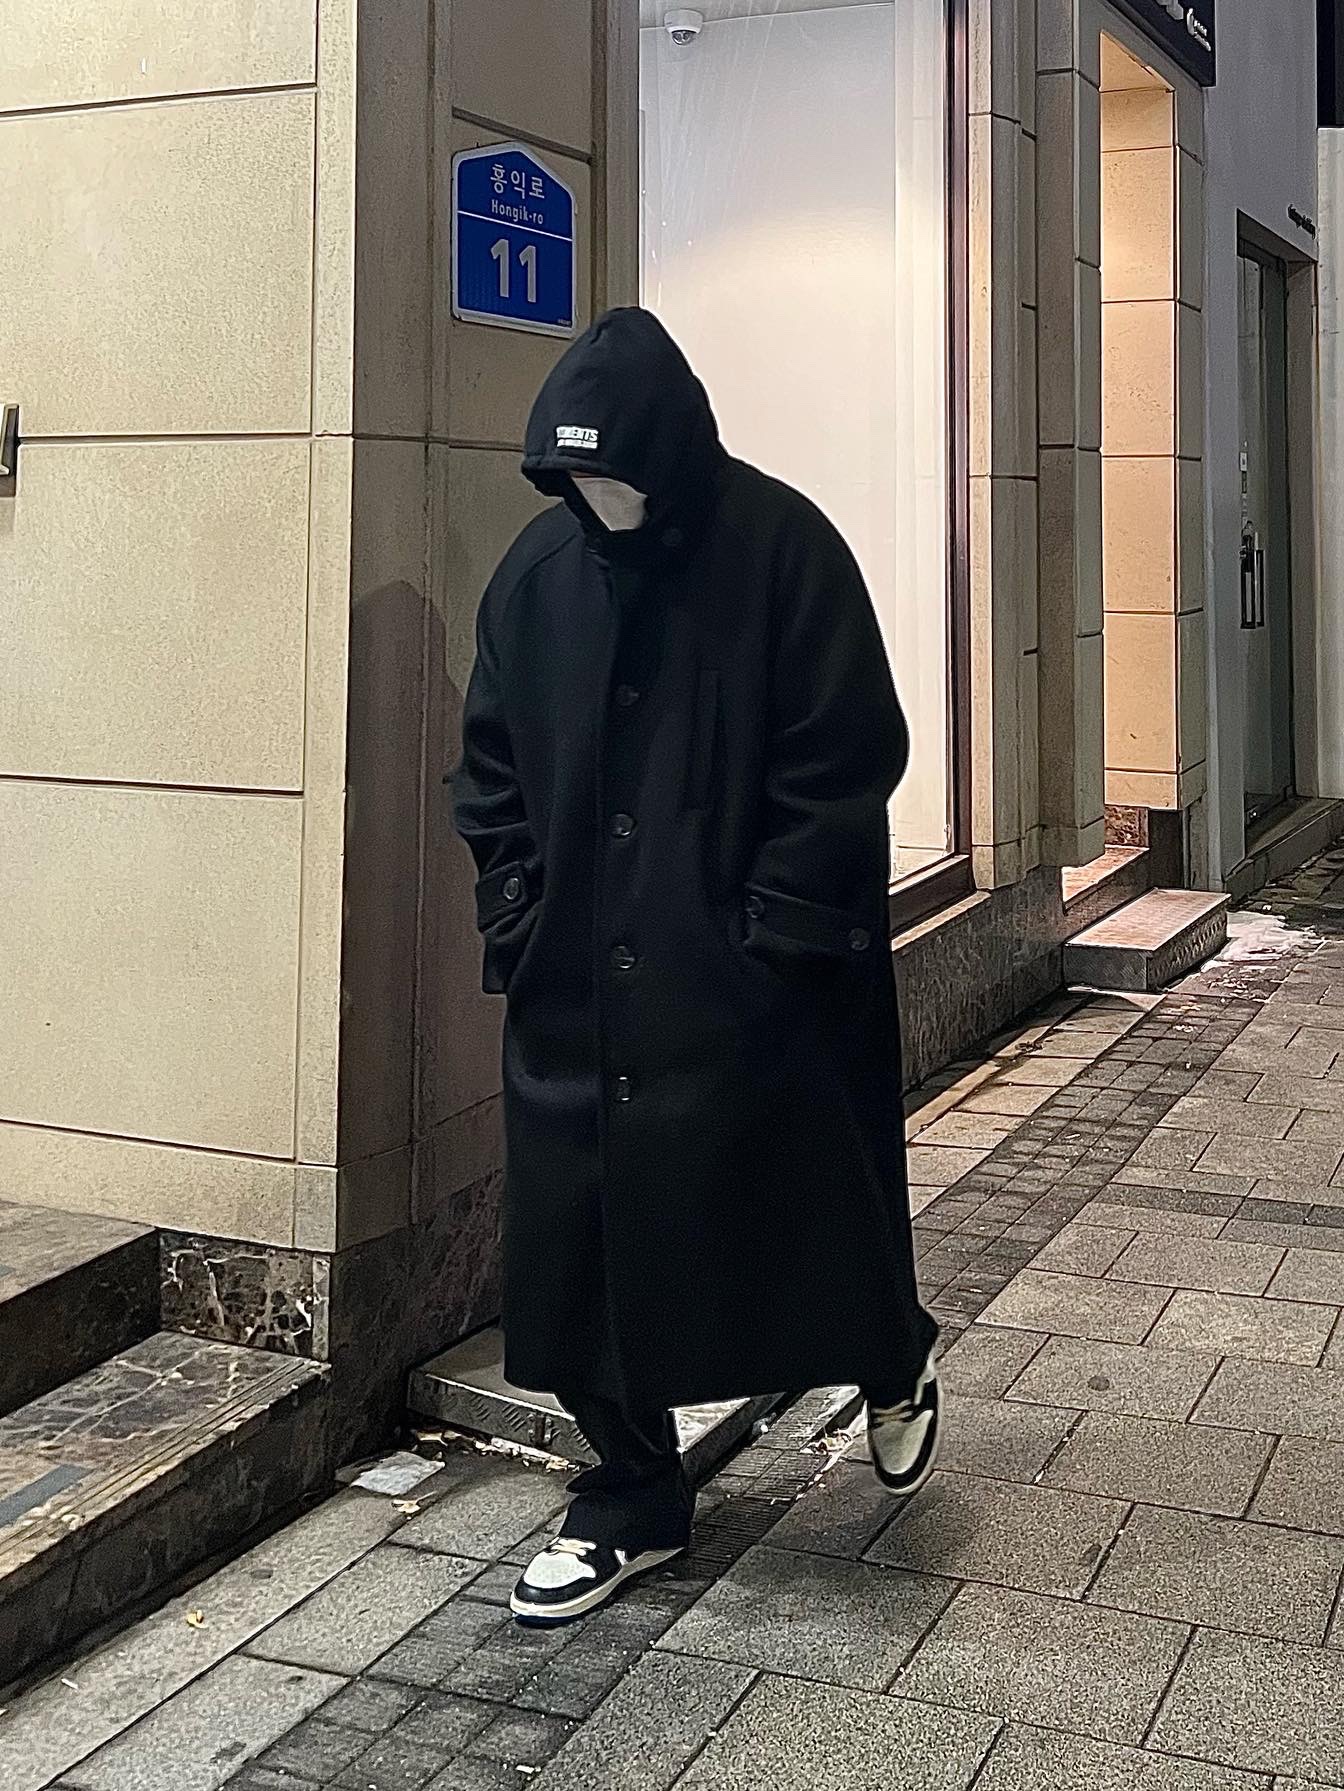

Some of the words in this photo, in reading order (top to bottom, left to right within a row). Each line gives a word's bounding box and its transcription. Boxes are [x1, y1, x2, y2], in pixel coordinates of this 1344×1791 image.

[490, 163, 545, 199] 홍익로
[491, 200, 544, 225] Hongik-ro
[490, 238, 537, 303] 11
